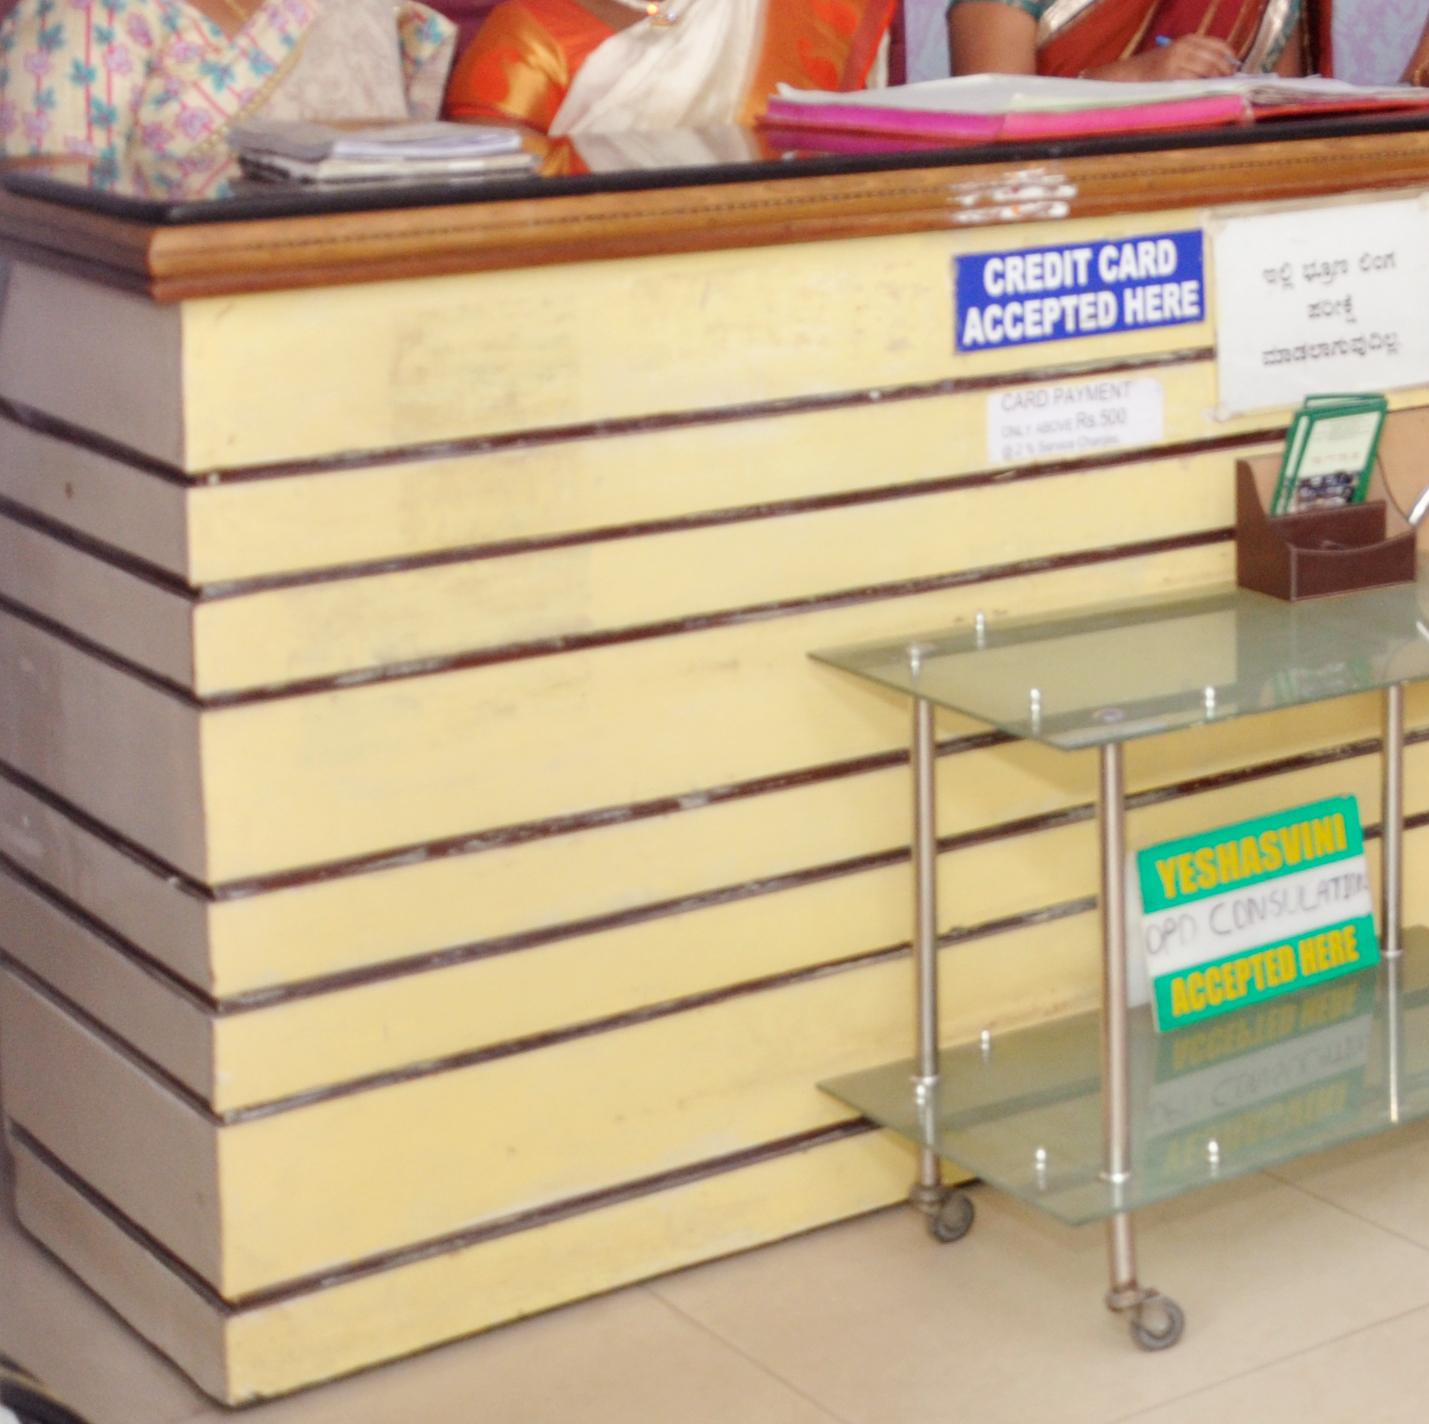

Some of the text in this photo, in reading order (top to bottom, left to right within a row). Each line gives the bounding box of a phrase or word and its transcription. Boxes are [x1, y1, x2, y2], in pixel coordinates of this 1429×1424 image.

[983, 239, 1178, 297] CREDIT CARD
[963, 280, 1200, 346] ACCEPTED HERE
[1001, 380, 1132, 412] CARD PAYMENT
[1155, 813, 1348, 900] YESHASVINI
[1145, 913, 1197, 955] OPD
[1171, 925, 1360, 1017] ACCEPTED HERE
